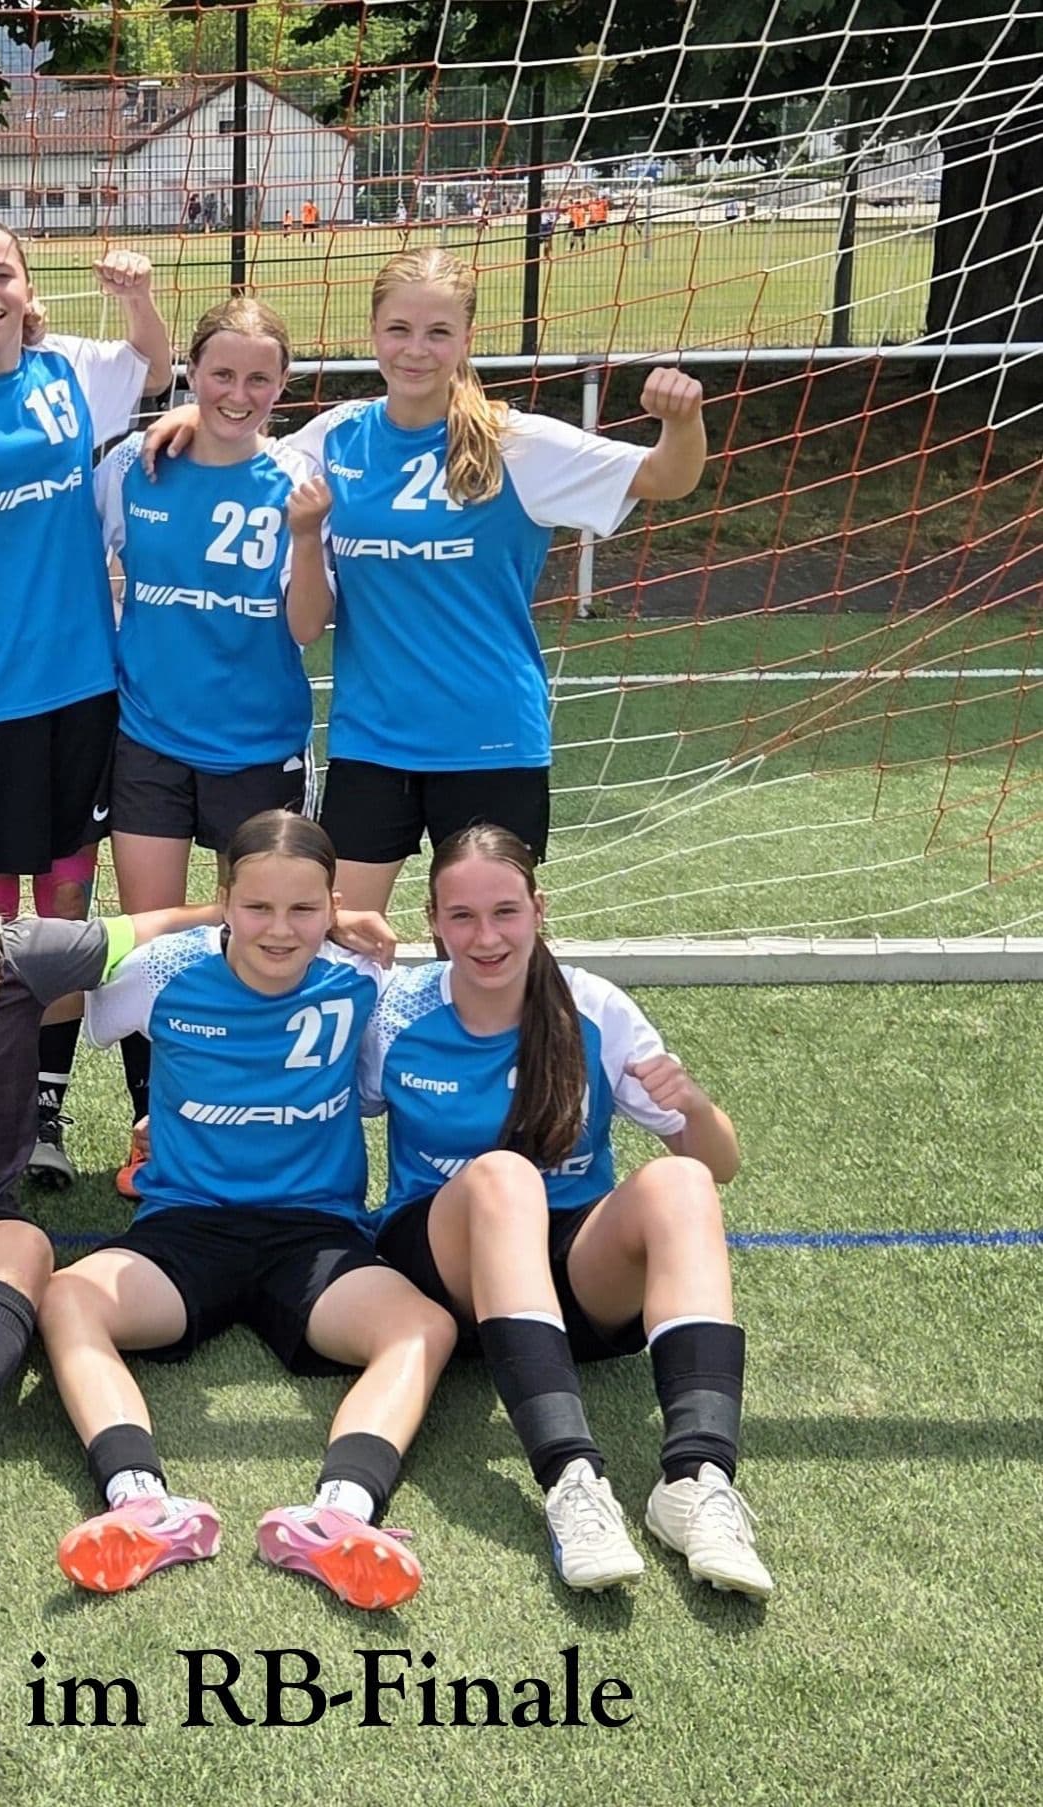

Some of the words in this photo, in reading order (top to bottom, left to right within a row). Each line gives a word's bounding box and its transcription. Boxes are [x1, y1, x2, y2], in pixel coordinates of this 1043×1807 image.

[24, 379, 79, 445] 13
[205, 501, 282, 569] 23
[351, 538, 474, 560] AMG
[165, 588, 277, 618] AMG
[169, 1018, 227, 1038] Kempa
[285, 998, 354, 1068] 27
[400, 1072, 459, 1095] Kempa
[235, 1087, 351, 1125] AMG
